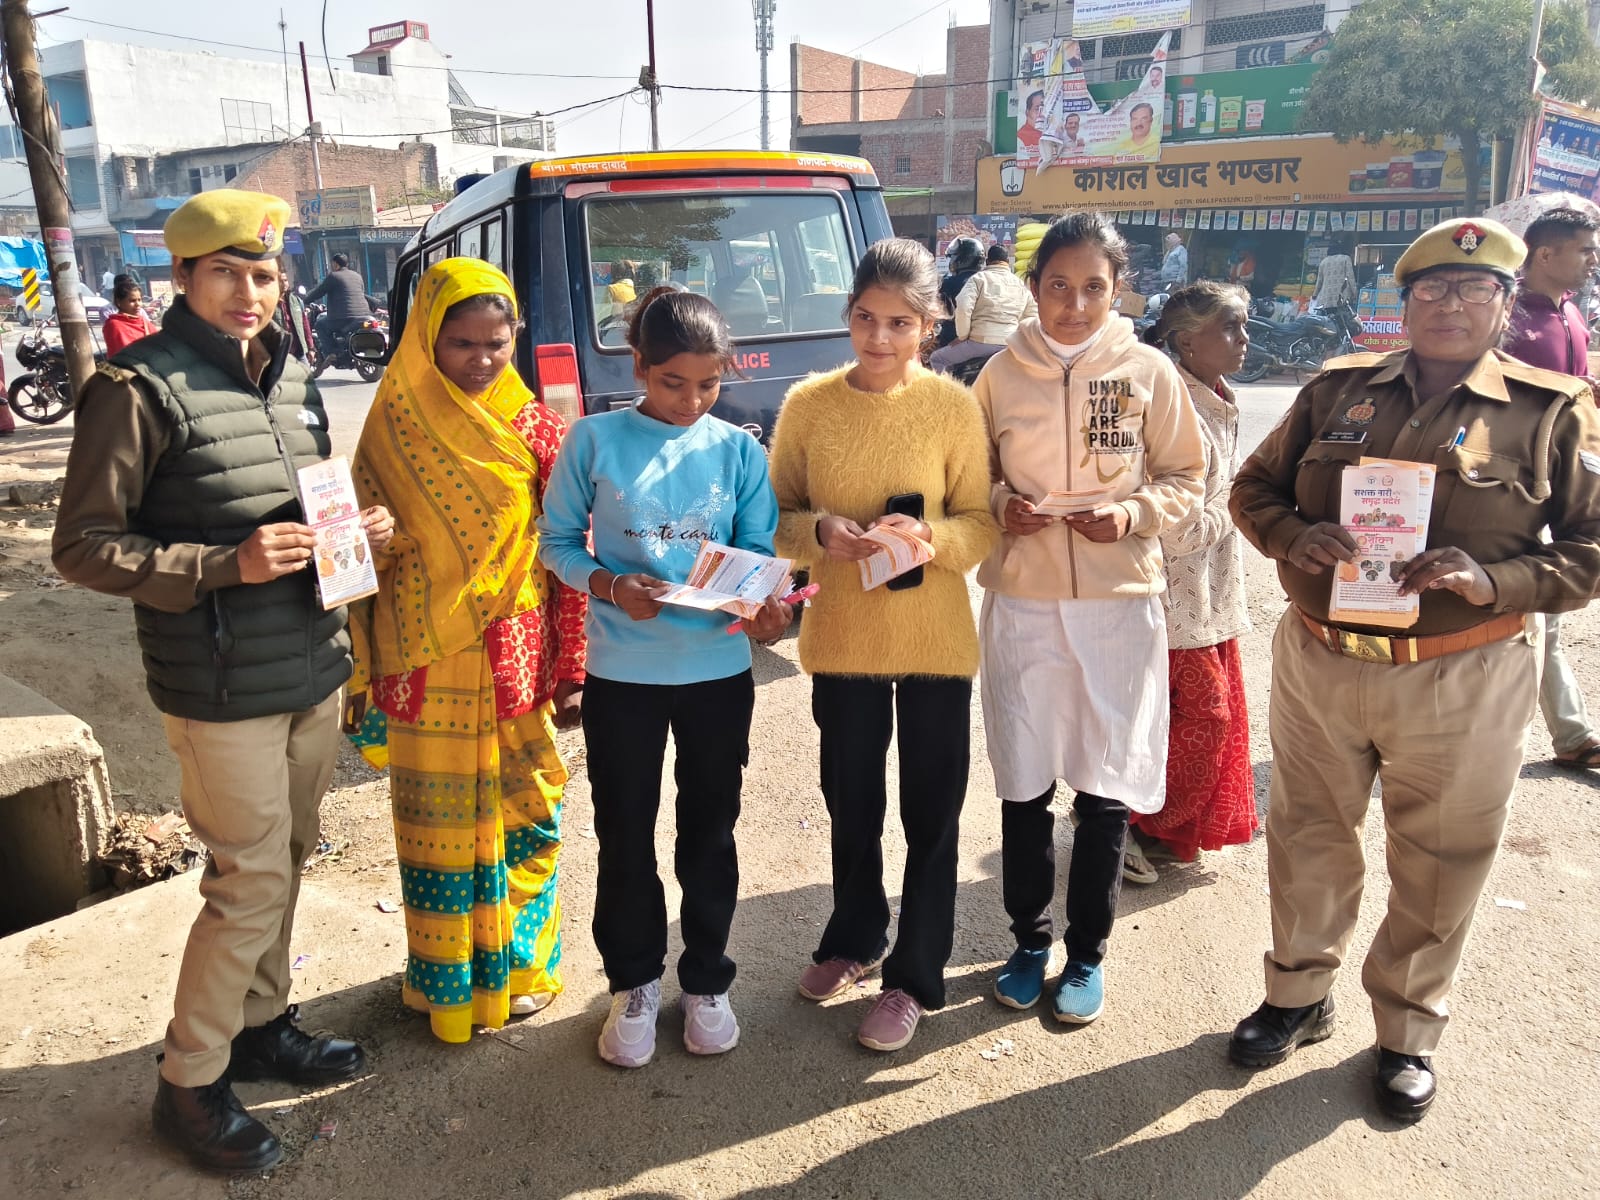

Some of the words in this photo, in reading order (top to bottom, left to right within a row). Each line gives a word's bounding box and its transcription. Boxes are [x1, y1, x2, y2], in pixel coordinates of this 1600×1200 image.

[1155, 162, 1211, 188] खाद
[1217, 157, 1301, 185] भण्डार
[733, 352, 771, 369] LICE
[1089, 380, 1135, 397] UNTIL
[1089, 398, 1119, 414] YOU
[1089, 415, 1120, 430] ARE
[1354, 489, 1376, 497] सशक्त
[1378, 488, 1392, 497] नारी
